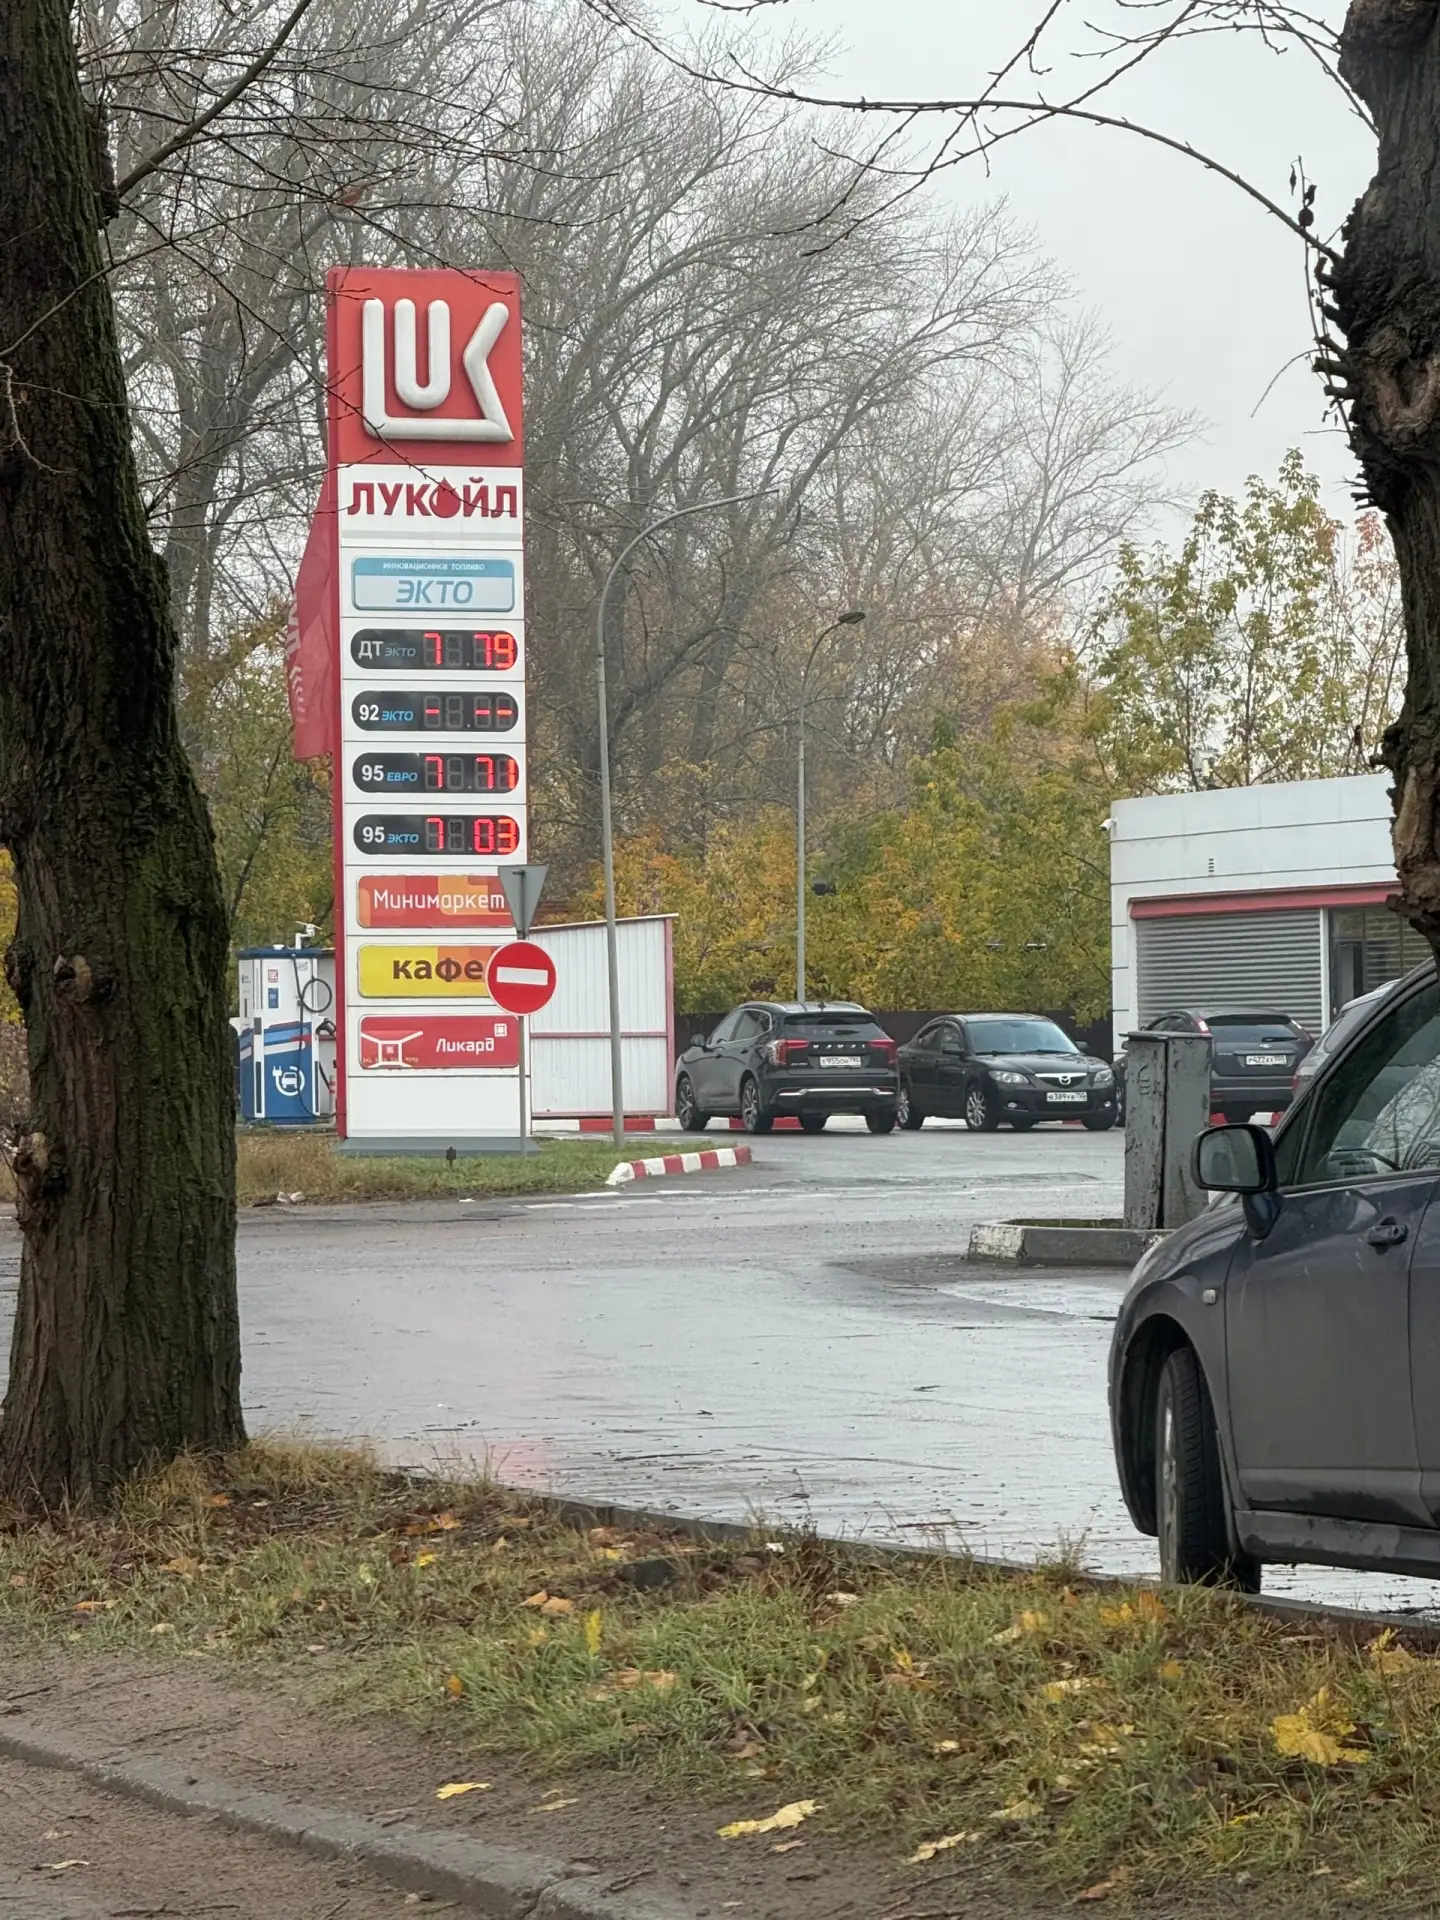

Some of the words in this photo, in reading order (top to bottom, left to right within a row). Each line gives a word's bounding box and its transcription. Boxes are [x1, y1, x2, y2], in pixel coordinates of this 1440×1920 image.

[347, 476, 518, 518] ЛУКОЙЛ
[383, 562, 448, 572] ИННОВАЦИОННОЕ
[451, 563, 485, 572] ТОПЛИВО
[396, 580, 474, 604] ЭКТО
[358, 641, 384, 660] ДТ
[384, 647, 416, 657] ЭКТО
[359, 704, 379, 721] 92
[381, 711, 414, 722] ЭКТО
[361, 764, 384, 782] 95
[386, 772, 418, 782] ЕВРО
[362, 826, 385, 843] 95
[387, 833, 419, 844] ЭКТО
[373, 888, 505, 913] Минимаркет
[393, 957, 484, 983] кафе
[436, 1037, 495, 1056] Ликард
